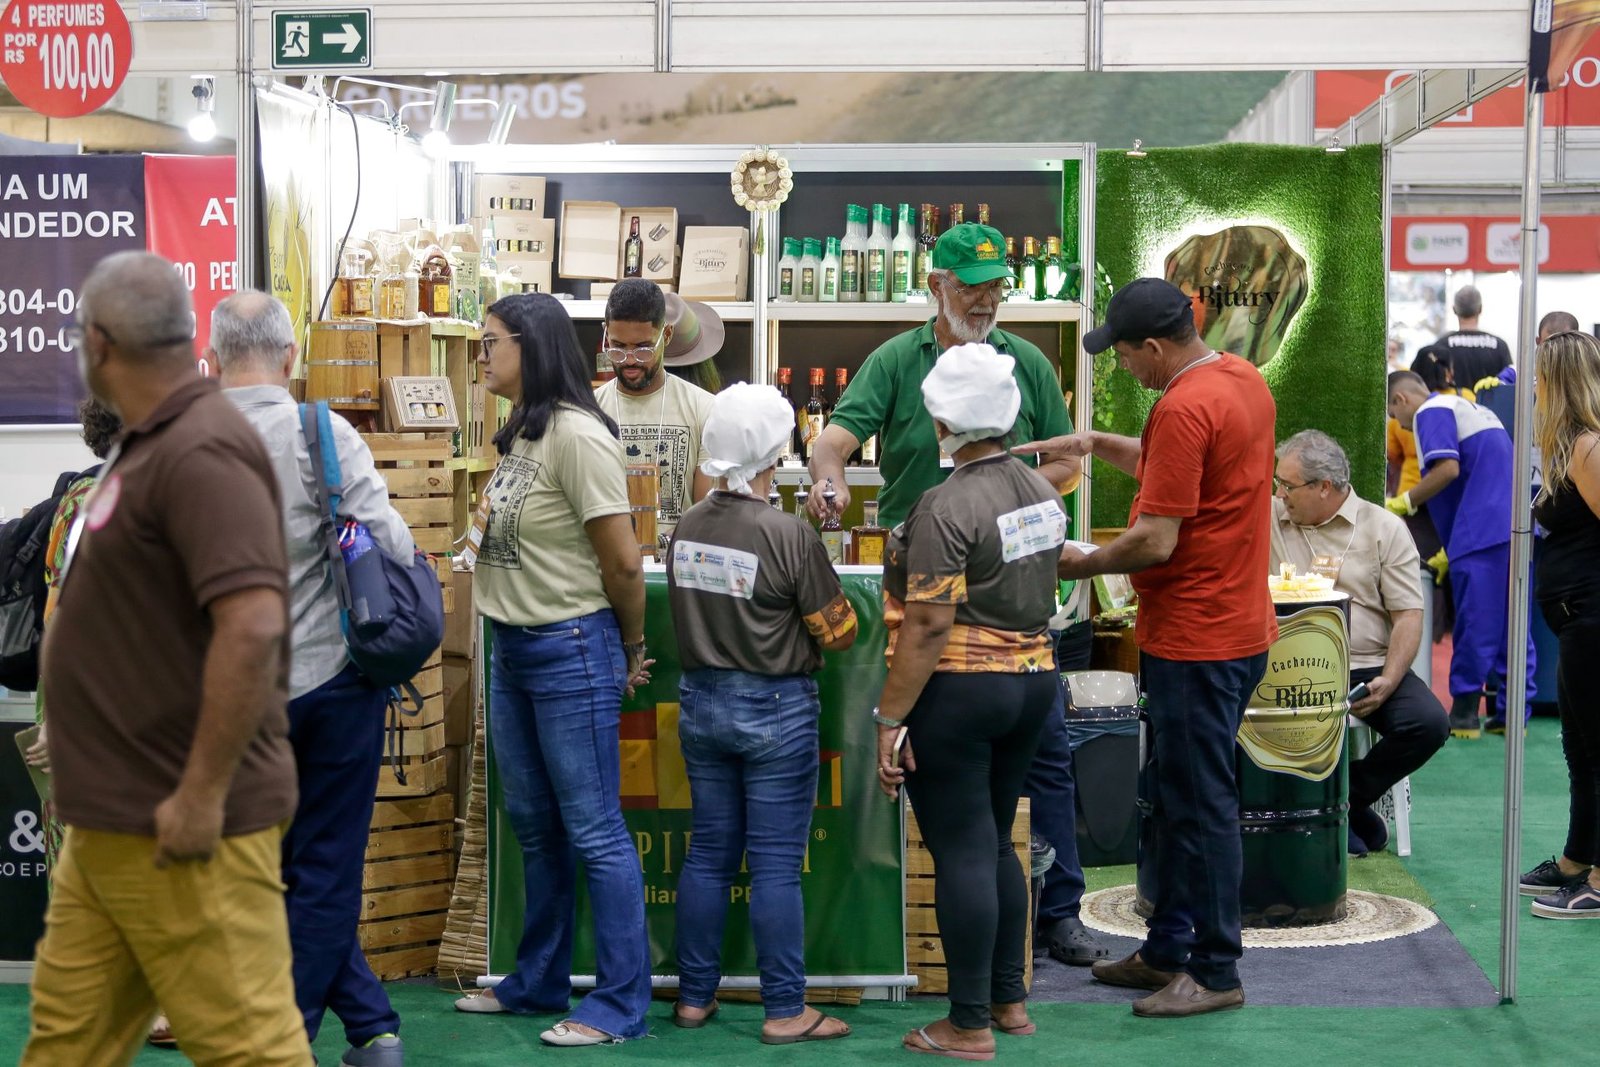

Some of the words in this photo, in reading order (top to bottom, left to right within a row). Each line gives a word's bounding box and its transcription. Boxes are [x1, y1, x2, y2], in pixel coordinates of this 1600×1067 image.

[11, 4, 21, 28] 4
[28, 3, 105, 28] PERFUMES
[4, 32, 38, 47] POR
[5, 49, 25, 65] R$
[39, 32, 115, 103] 100,00
[38, 173, 88, 200] UM
[1196, 280, 1281, 317] Bitury
[1268, 681, 1337, 718] Bitury
[9, 809, 46, 853] &
